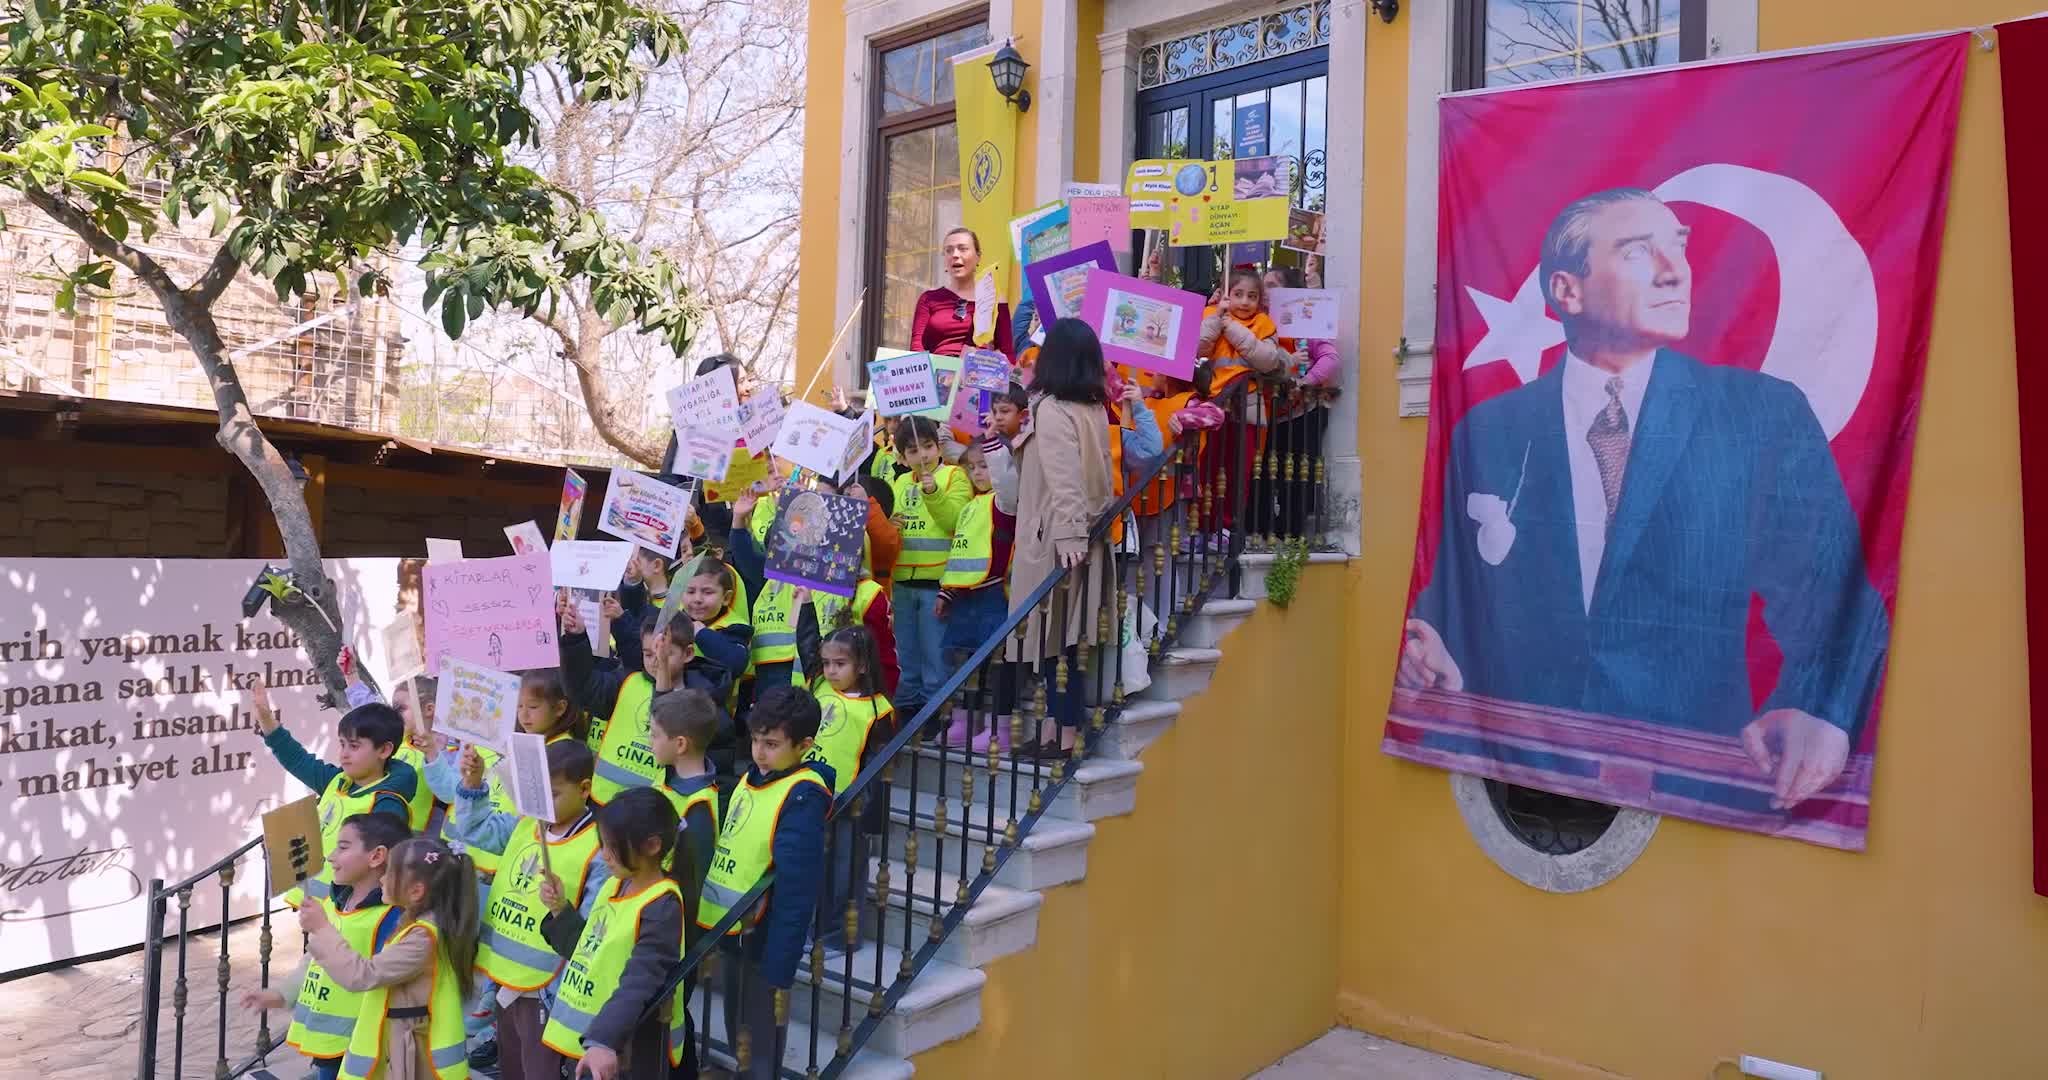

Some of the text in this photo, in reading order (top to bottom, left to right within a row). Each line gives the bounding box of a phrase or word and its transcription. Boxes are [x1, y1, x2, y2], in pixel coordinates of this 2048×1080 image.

[890, 363, 928, 377] BİR KİTAP
[888, 395, 927, 409] DEMEKTİR
[899, 381, 925, 393] HAYAT
[0, 623, 304, 665] rih yapmak kada
[0, 661, 322, 716] pana sadık kalma
[0, 716, 117, 754] kikat,
[17, 744, 257, 798] mahiyet alır.
[491, 901, 536, 932] ÇINAR
[564, 969, 595, 998] INAR
